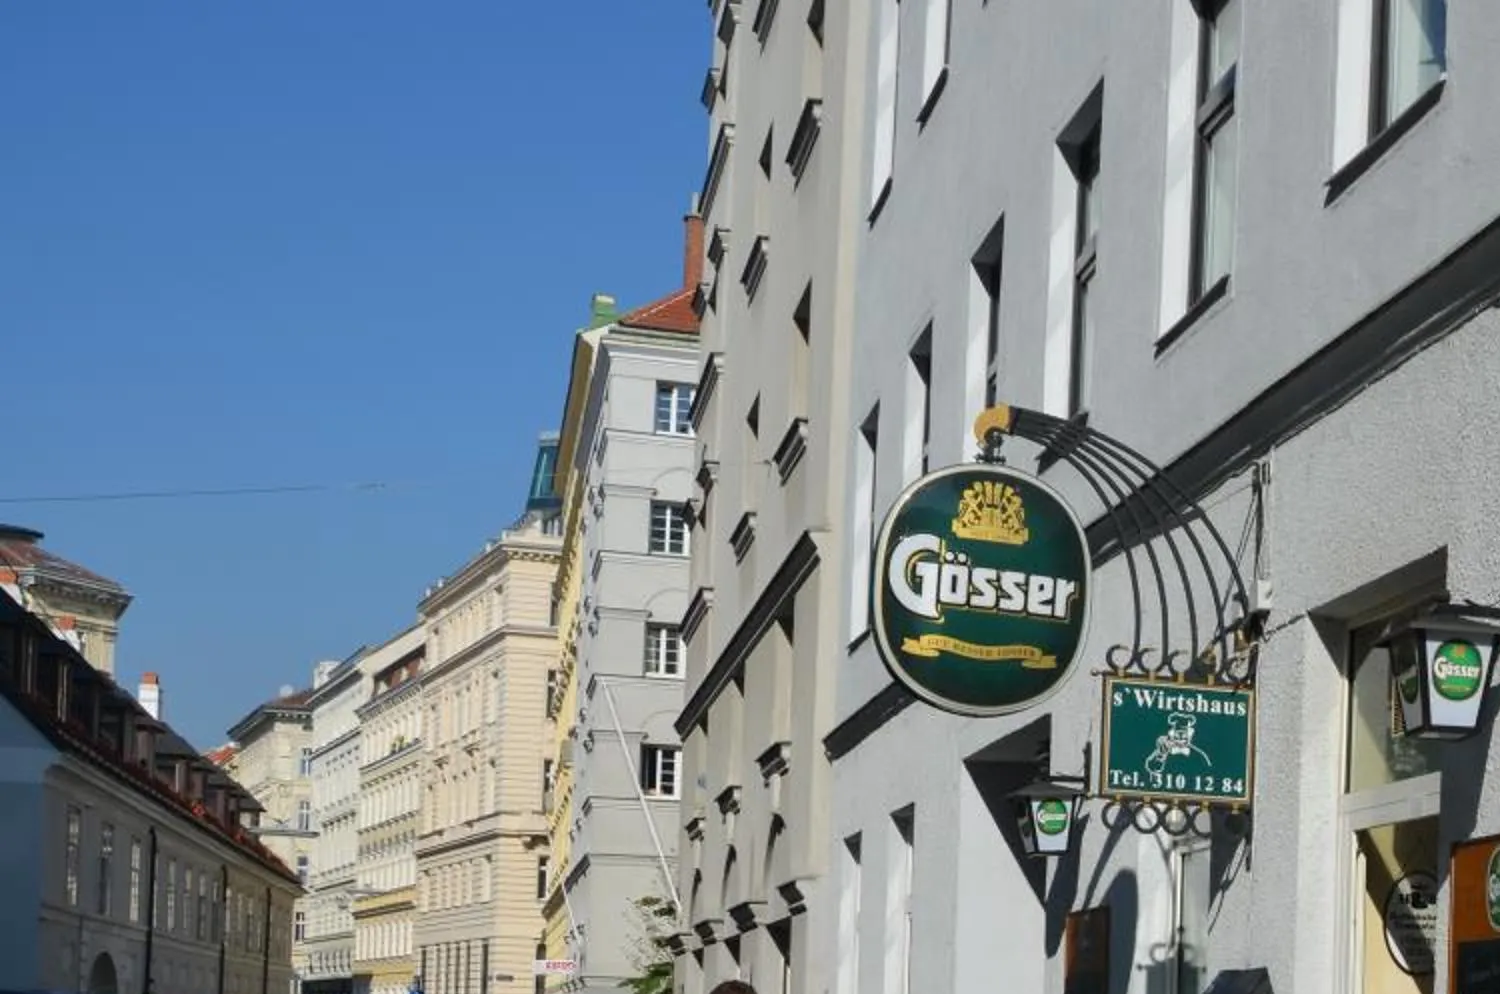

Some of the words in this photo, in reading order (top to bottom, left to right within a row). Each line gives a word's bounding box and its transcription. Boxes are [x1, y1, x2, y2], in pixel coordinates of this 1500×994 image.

[888, 532, 1078, 620] Gösser
[1433, 655, 1481, 680] Gösser
[1110, 769, 1145, 787] Tel.
[1151, 773, 1186, 790] 310
[1195, 776, 1215, 792] 12
[1221, 777, 1243, 794] 84
